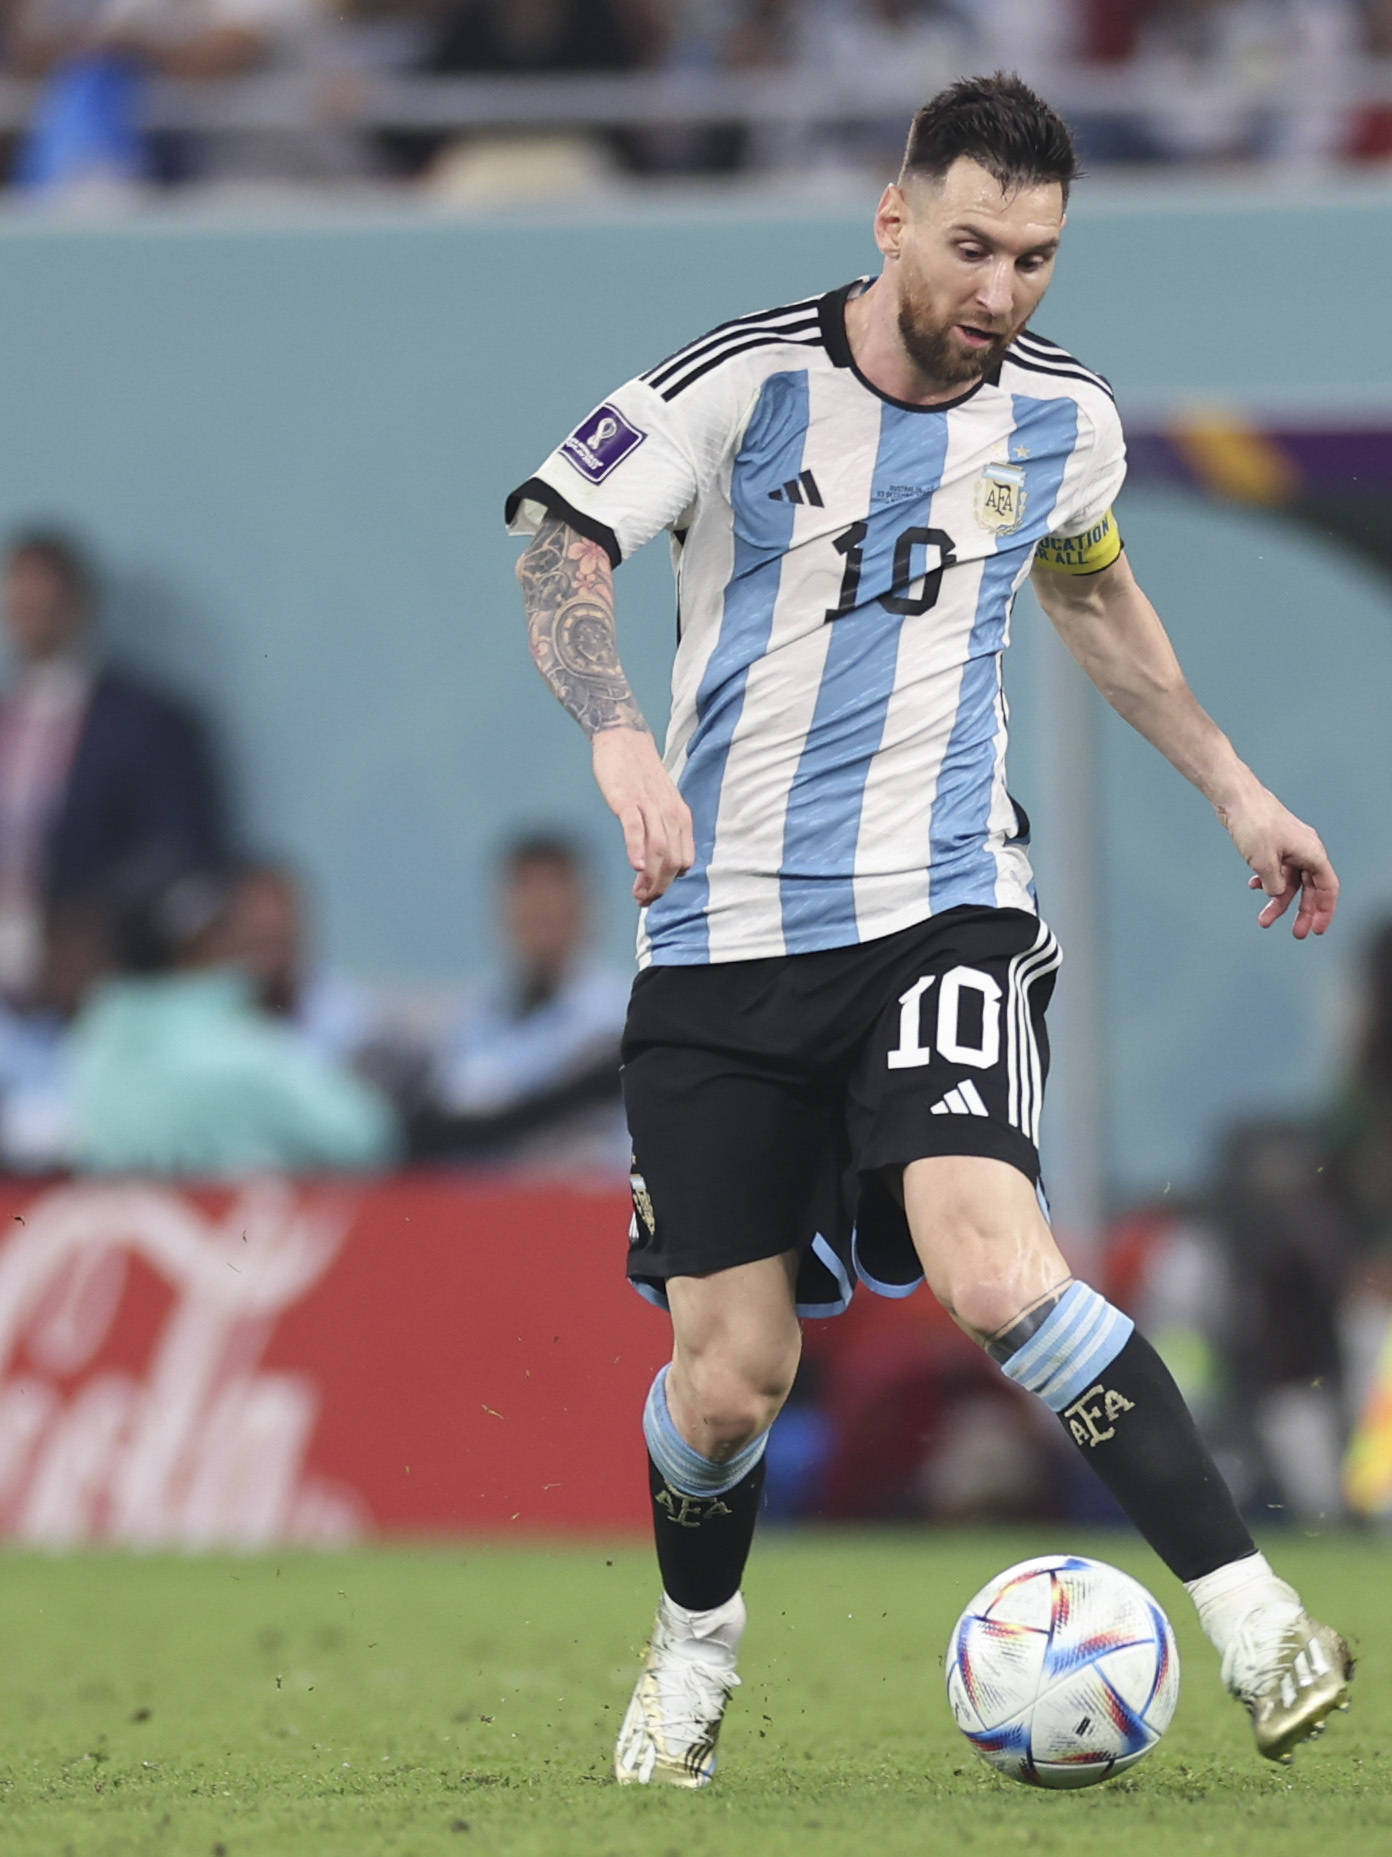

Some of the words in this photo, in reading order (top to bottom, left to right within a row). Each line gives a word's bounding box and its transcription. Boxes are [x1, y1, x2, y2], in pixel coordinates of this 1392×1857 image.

[985, 480, 1013, 516] AFA
[1034, 547, 1049, 560] R
[1056, 551, 1089, 565] ALL
[1039, 516, 1109, 551] UCATION
[823, 520, 957, 617] 10
[887, 965, 1003, 1070] 10
[1064, 1384, 1136, 1447] AFA
